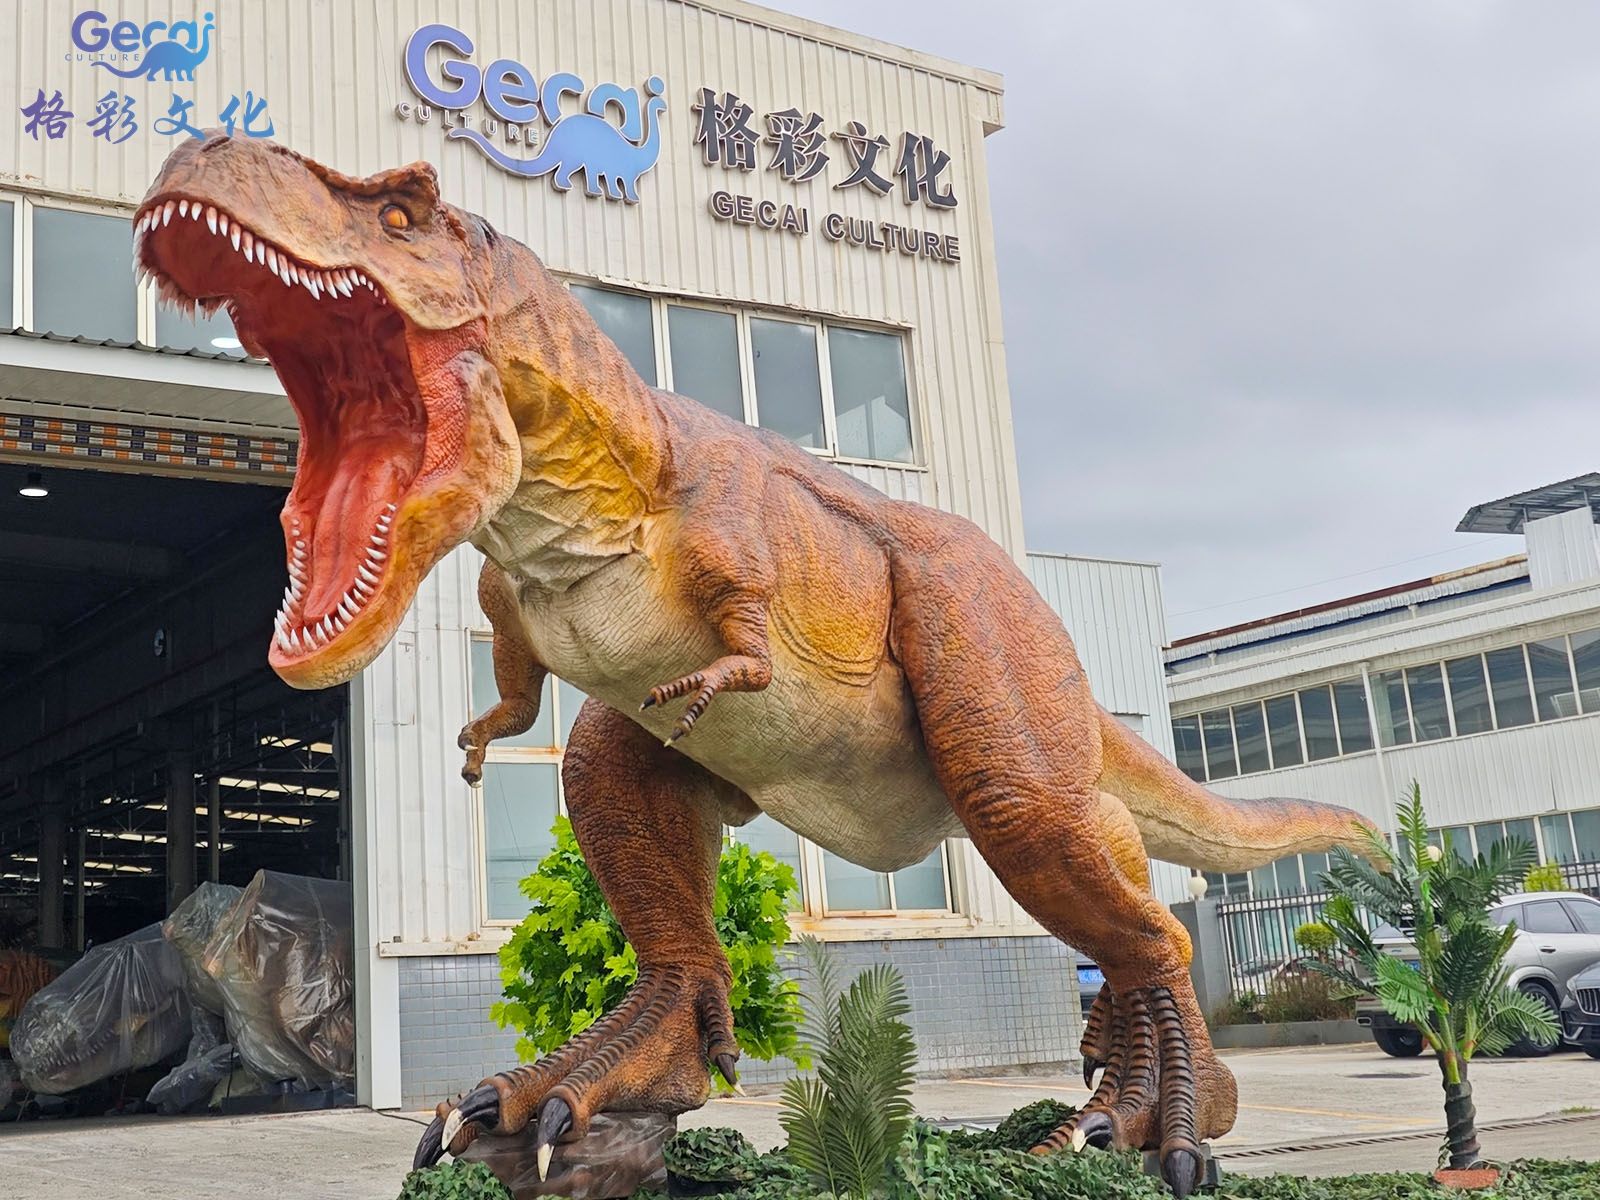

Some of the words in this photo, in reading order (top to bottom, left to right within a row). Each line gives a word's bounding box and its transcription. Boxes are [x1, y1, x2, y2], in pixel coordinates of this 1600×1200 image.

[396, 102, 544, 147] CULTURE
[404, 23, 667, 143] Gecai
[692, 87, 959, 210] 格彩文化
[709, 190, 810, 237] GECAI
[822, 212, 962, 264] CULTURE
